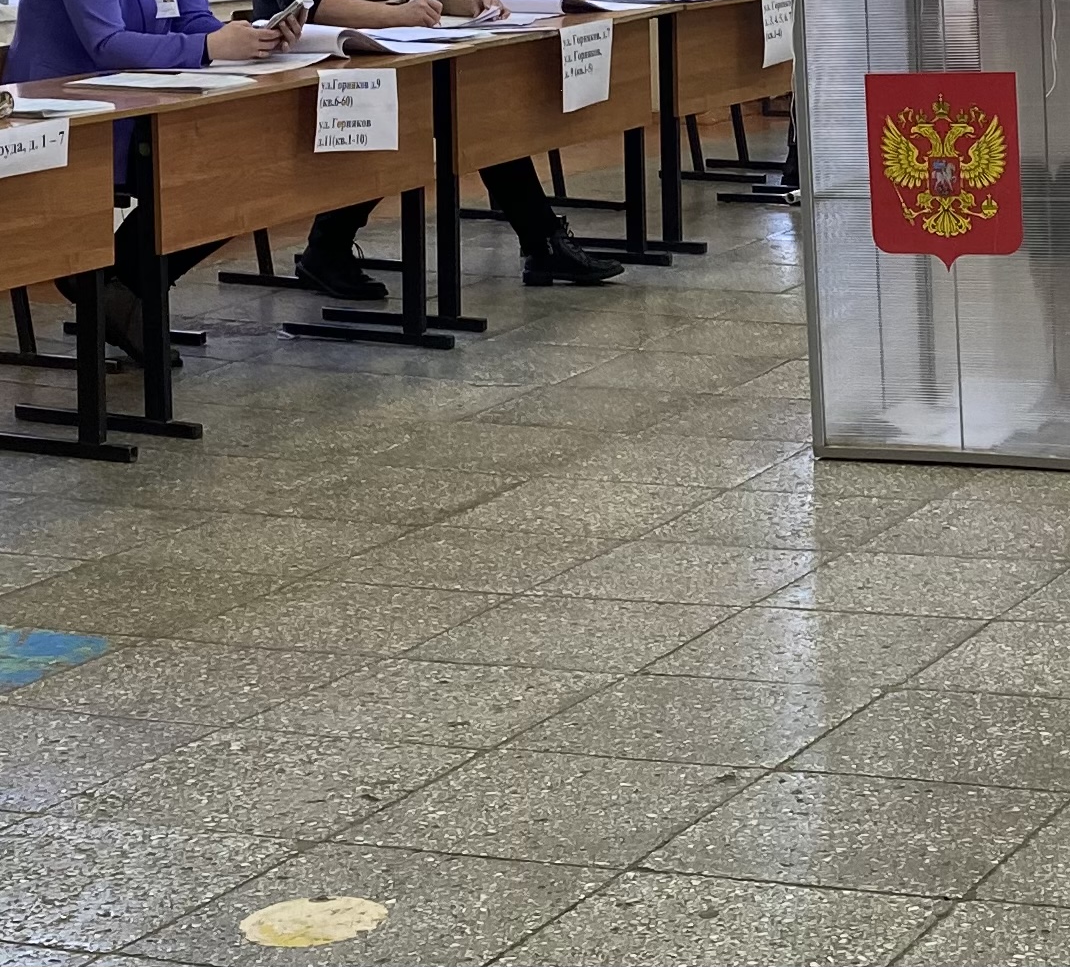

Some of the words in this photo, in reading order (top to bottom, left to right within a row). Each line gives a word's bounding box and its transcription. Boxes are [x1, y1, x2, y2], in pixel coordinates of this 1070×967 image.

[320, 96, 353, 108] (кв.6-60)
[318, 121, 330, 133] ул.
[331, 118, 371, 131] Горняков
[29, 140, 38, 153] д.
[58, 131, 65, 145] 7
